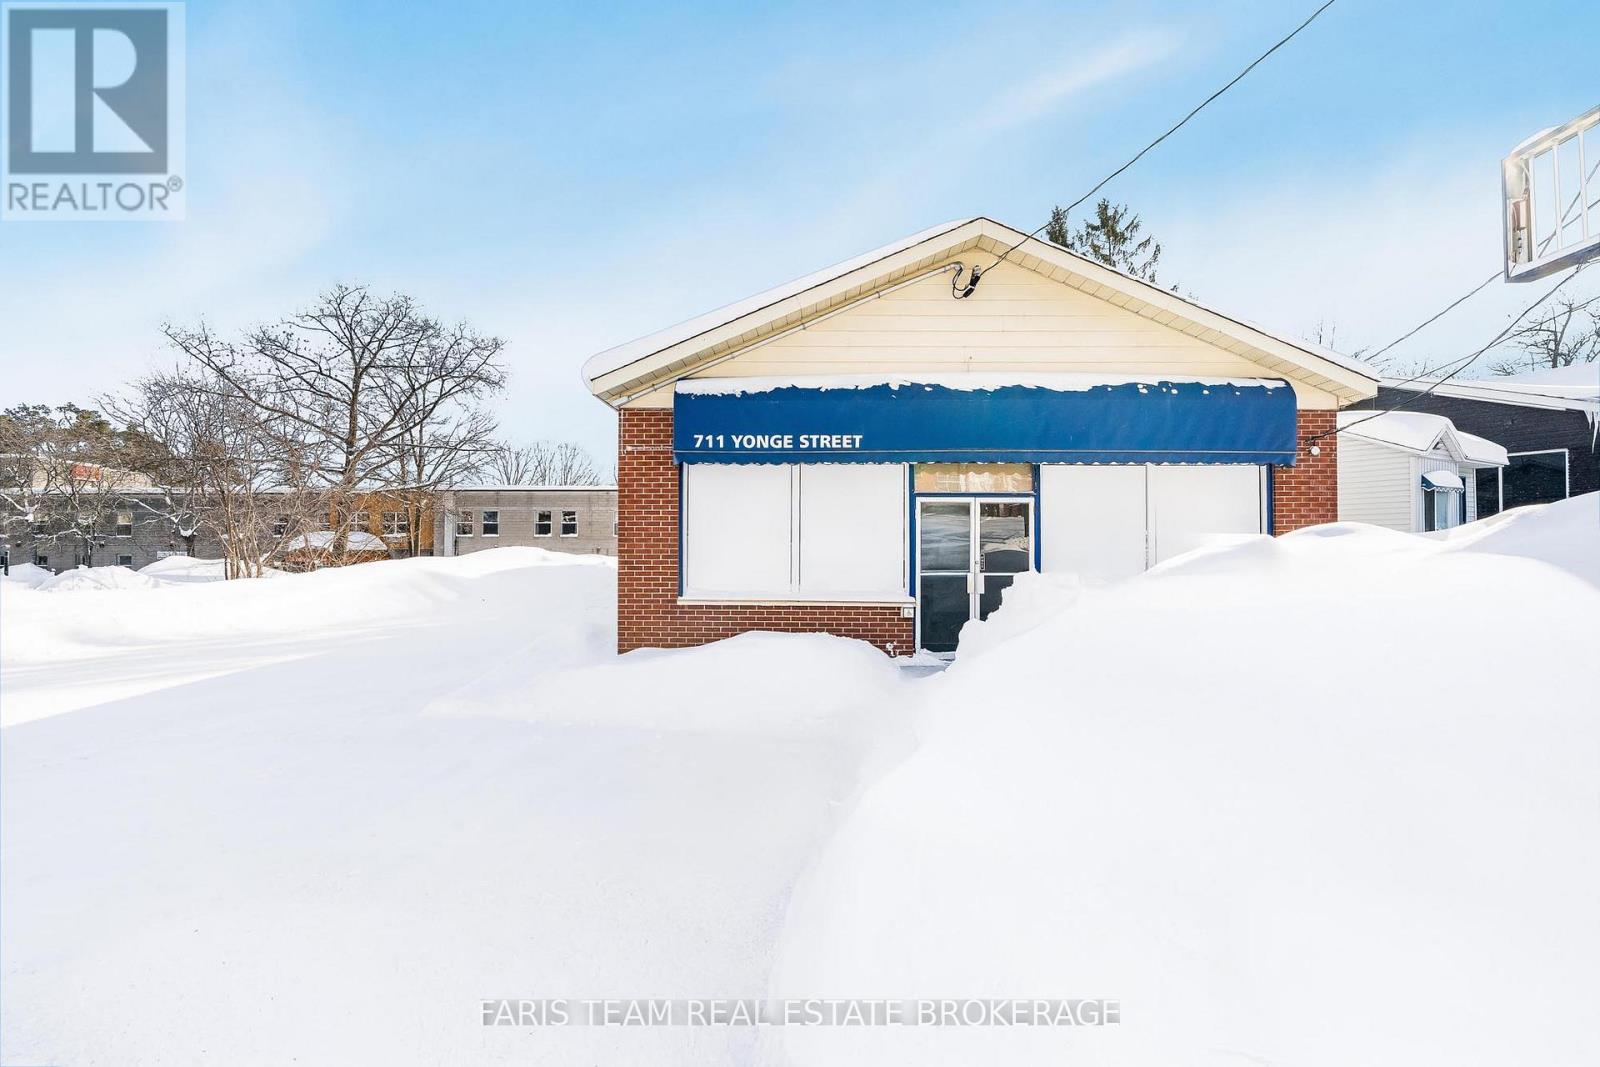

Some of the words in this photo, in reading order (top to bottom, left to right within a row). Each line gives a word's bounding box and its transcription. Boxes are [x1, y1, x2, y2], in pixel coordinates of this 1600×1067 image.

[694, 434, 725, 448] 711
[732, 434, 793, 448] YONGE
[799, 434, 863, 448] STREET
